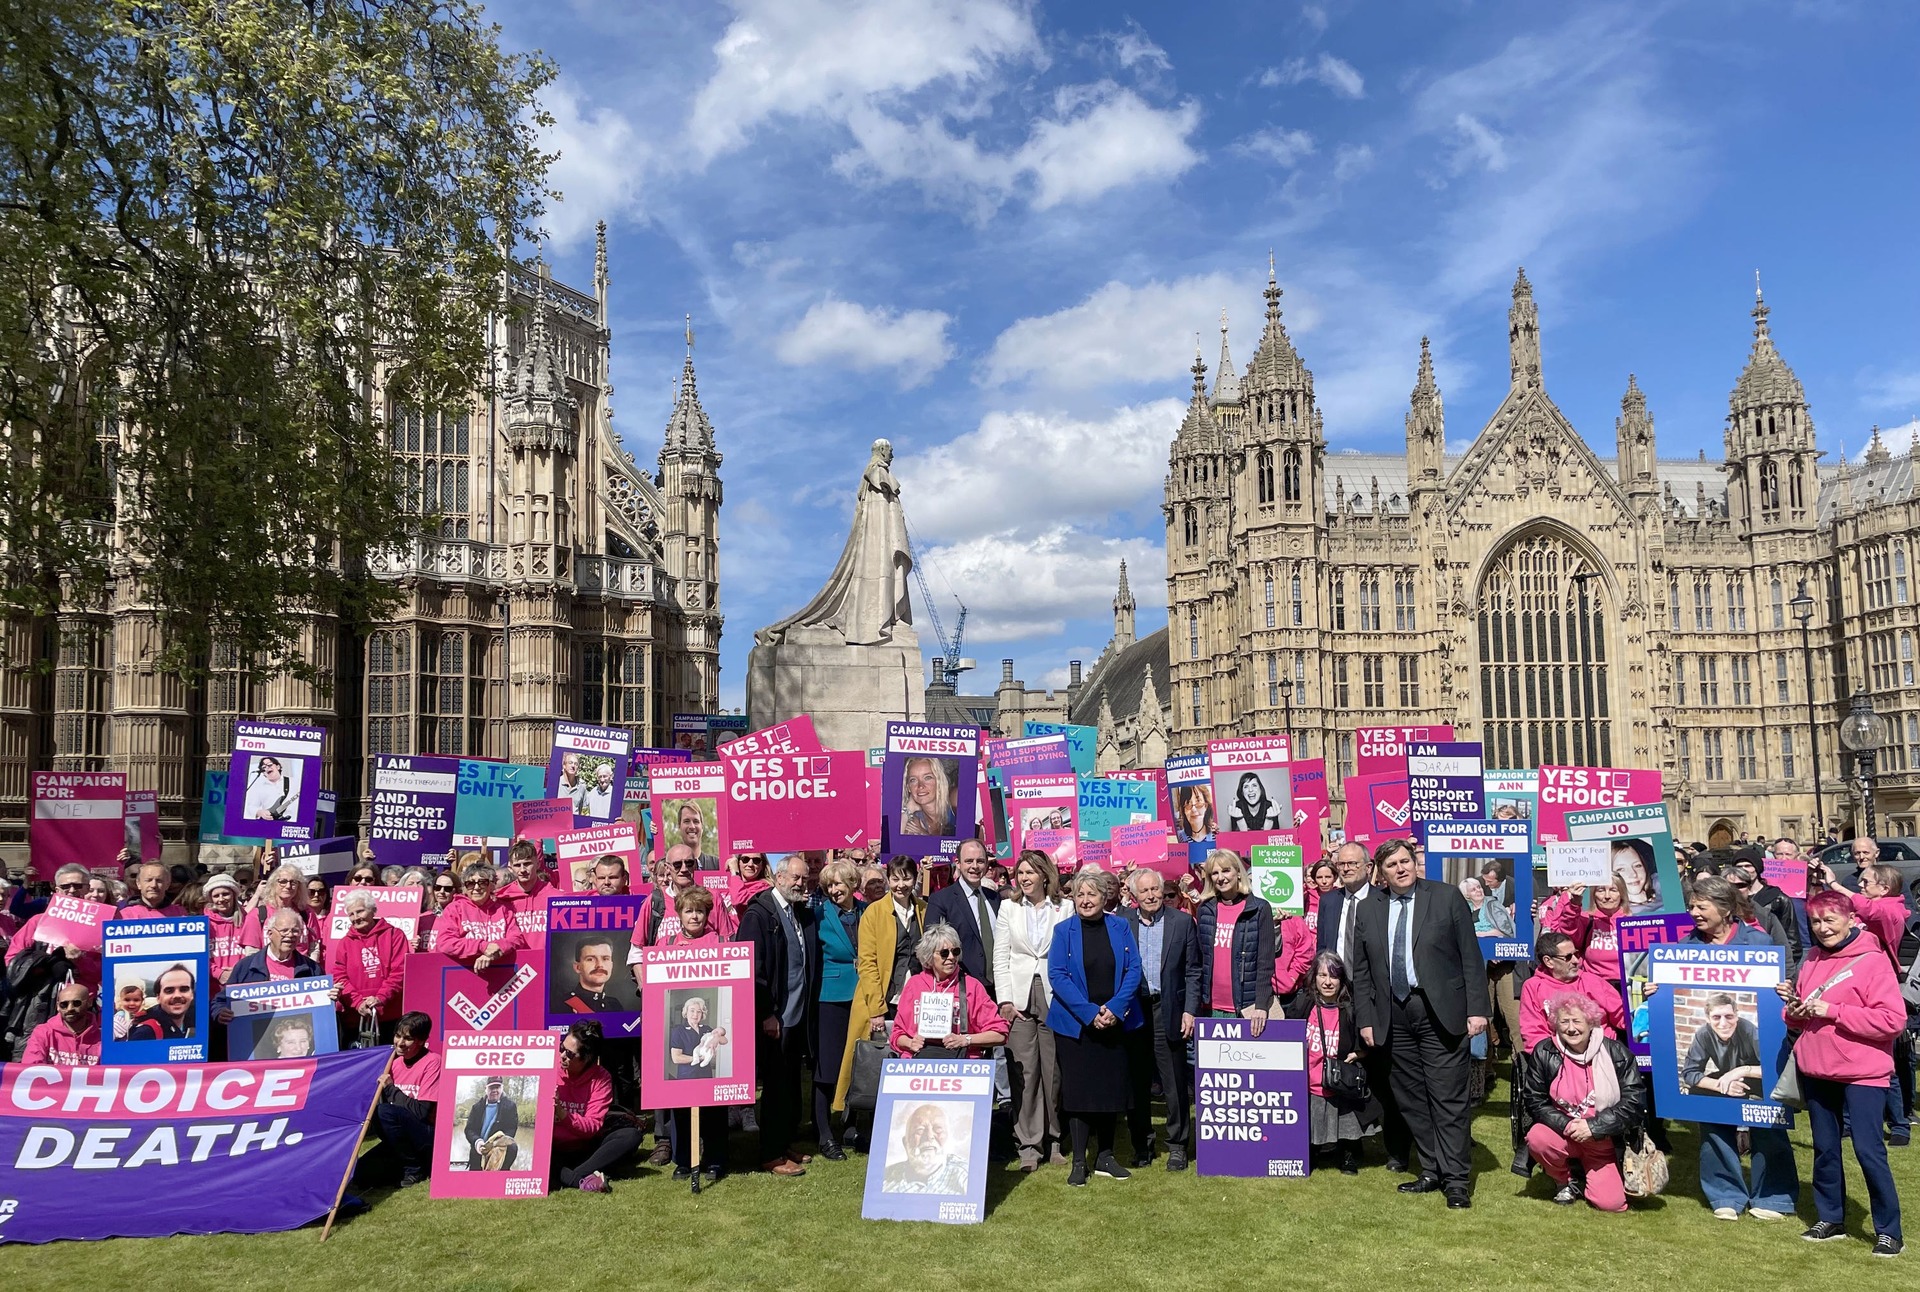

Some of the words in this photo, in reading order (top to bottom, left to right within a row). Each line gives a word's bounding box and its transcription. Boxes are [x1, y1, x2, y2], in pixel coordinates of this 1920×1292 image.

[709, 719, 748, 728] GEORGE.
[1026, 723, 1053, 735] YES
[238, 725, 297, 738] CAMPAIGN
[299, 730, 322, 741] FOR
[557, 725, 607, 738] CAMPAIGN
[609, 731, 629, 741] FOR
[890, 725, 950, 737] CAMPAIGN
[953, 728, 976, 738] FOR
[1360, 729, 1396, 743] YES
[240, 738, 266, 749] Tom
[573, 737, 610, 751] DAVID
[720, 736, 760, 756] YES
[898, 739, 968, 753] VANESSA
[991, 743, 1005, 752] I'M
[1211, 740, 1264, 751] CAMPAIGN
[1266, 738, 1287, 747] FOR
[992, 750, 1011, 760] AND
[1018, 744, 1059, 756] SUPPORT
[1227, 751, 1272, 763] PAOLA
[1417, 745, 1438, 756] AM
[377, 757, 383, 768] I
[387, 758, 411, 770] AM
[994, 755, 1036, 767] ASSISTED
[1038, 751, 1068, 761] DYING.
[1166, 758, 1202, 769] CAMPAIGN
[459, 763, 479, 779] ES
[651, 767, 701, 777] CAMPAIGN
[704, 765, 724, 775] FOR
[730, 757, 784, 779] YES
[1416, 759, 1459, 773] SARAH
[36, 775, 122, 786] CAMPAIGN
[1178, 768, 1205, 780] JANE
[1543, 769, 1589, 787] YES
[674, 779, 701, 791] ROB
[731, 778, 837, 802] CHOICE.
[1080, 781, 1111, 794] YES
[1410, 778, 1438, 789] AND
[1498, 782, 1524, 790] ANN
[36, 788, 75, 798] FOR:
[318, 792, 336, 801] FOR
[375, 792, 408, 805] AND
[412, 794, 418, 804] I
[1016, 788, 1042, 798] Gypie
[1411, 790, 1474, 801] SUPPORT
[1541, 786, 1635, 807] CHOICE.
[1079, 795, 1148, 810] DIGNITY.
[1412, 801, 1479, 813] ASSISTED
[374, 804, 445, 818] SUPPORT
[522, 806, 571, 815] COMPASSION
[1380, 802, 1397, 818] YES
[1568, 811, 1634, 825] CAMPAIGN
[1637, 807, 1664, 817] FOR
[373, 816, 447, 830] ASSISTED
[1120, 824, 1146, 833] CHOICE
[1427, 823, 1497, 834] CAMPAIGN
[1501, 823, 1527, 834] FOR
[1608, 823, 1630, 835] JO
[372, 827, 423, 841] DYING.
[557, 829, 611, 843] CAMPAIGN
[613, 826, 634, 836] FOR
[1120, 829, 1166, 840] COMPASSION
[579, 841, 615, 855] ANDY
[1120, 838, 1149, 847] DIGNITY
[1450, 838, 1505, 850] DIANE
[280, 846, 286, 857] I
[288, 843, 310, 856] AM
[1258, 849, 1271, 857] It's
[1272, 849, 1295, 857] about
[1558, 847, 1586, 855] DON'T
[1264, 856, 1290, 864] choice
[1579, 869, 1603, 879] Dying!
[1269, 887, 1290, 896] EOLI
[54, 895, 79, 910] YES
[47, 906, 97, 927] CHOICE.
[105, 923, 175, 937] CAMPAIGN
[178, 921, 206, 932] FOR
[109, 942, 132, 954] Ian
[647, 948, 718, 962] CAMPAIGN
[722, 946, 750, 958] FOR
[1653, 948, 1739, 962] CAMPAIGN
[1744, 950, 1779, 963] FOR
[665, 963, 731, 979] WINNIE
[1679, 966, 1752, 983] TERRY
[230, 982, 300, 999] CAMPAIGN
[303, 979, 330, 991] FOR
[248, 994, 315, 1013] STELLA
[453, 995, 477, 1019] YES
[923, 995, 951, 1008] Living.
[922, 1011, 949, 1024] Dying.
[1199, 1022, 1205, 1038] I
[1211, 1023, 1242, 1038] AM
[448, 1035, 523, 1046] CAMPAIGN
[527, 1035, 556, 1046] FOR
[169, 1048, 202, 1056] DIGNITY
[177, 1053, 204, 1061] DYING.
[475, 1051, 525, 1066] GREG
[1218, 1042, 1266, 1063] Rosie
[886, 1063, 958, 1074] CAMPAIGN
[963, 1064, 991, 1074] FOR
[909, 1078, 963, 1092] GILES
[1200, 1072, 1242, 1088] AND
[1248, 1073, 1255, 1089] I
[11, 1065, 306, 1114] CHOICE
[714, 1087, 749, 1095] DIGNITY
[723, 1093, 752, 1101] DYING.
[1200, 1090, 1293, 1107] SUPPORT
[1200, 1107, 1299, 1124] ASSISTED
[1742, 1108, 1785, 1118] DIGNITY
[1742, 1114, 1753, 1122] IN
[1755, 1115, 1790, 1125] DYING.
[1200, 1125, 1268, 1142] DYING.
[14, 1117, 303, 1169] DEATH.
[505, 1181, 542, 1189] DIGNITY
[938, 1212, 948, 1220] IN
[949, 1213, 979, 1221] DYING.
[940, 1206, 977, 1214] DIGNITY
